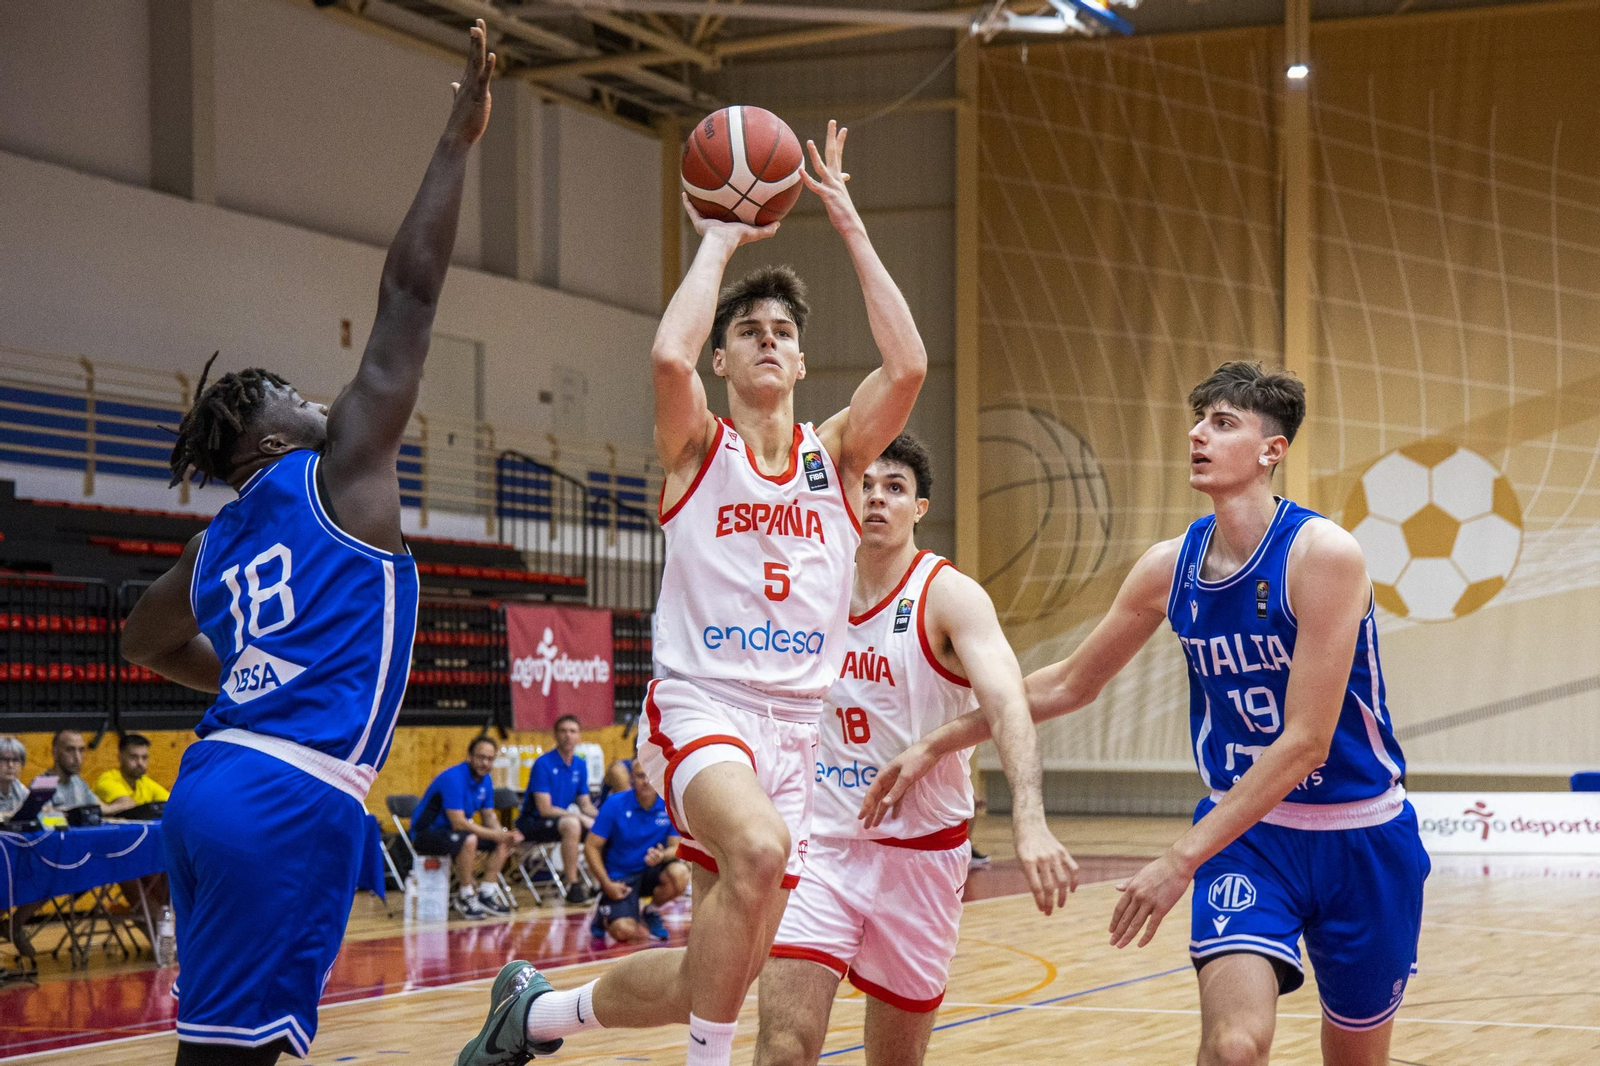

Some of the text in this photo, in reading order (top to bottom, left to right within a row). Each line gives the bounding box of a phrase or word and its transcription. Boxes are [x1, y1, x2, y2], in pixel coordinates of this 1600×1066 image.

[809, 472, 825, 482] FIBA
[220, 543, 295, 653] 18
[764, 562, 790, 602] 5
[703, 620, 825, 655] endesa
[232, 662, 281, 694] IBSA
[840, 646, 895, 687] AÑA
[835, 707, 871, 745] 18
[1227, 686, 1281, 733] 19
[815, 760, 880, 788] ende
[1421, 804, 1506, 840] ogroño
[1210, 875, 1254, 909] MG
